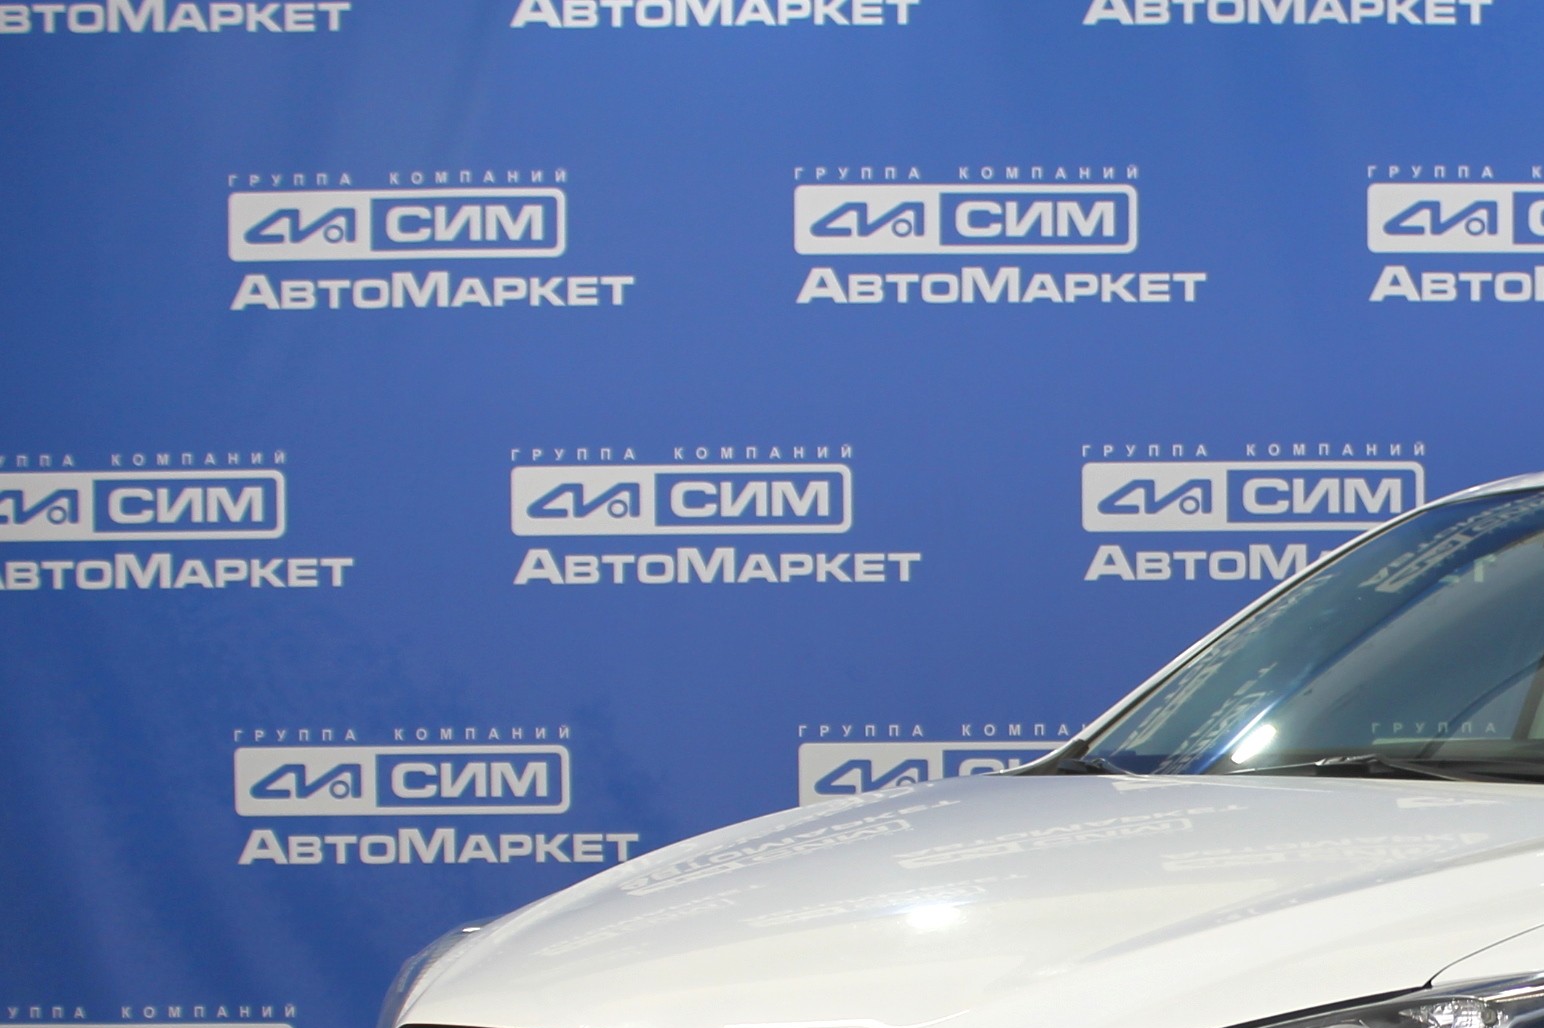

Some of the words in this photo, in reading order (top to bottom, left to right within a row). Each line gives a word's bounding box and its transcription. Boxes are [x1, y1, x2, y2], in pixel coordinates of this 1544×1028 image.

[0, 0, 351, 33] втоМаркет
[227, 172, 352, 187] ГРУППА
[389, 168, 567, 185] КОМПАНИЙ
[794, 166, 920, 180] ГРУППА
[958, 164, 1138, 180] КОМПАНИЙ
[1367, 164, 1494, 178] ГРУППА
[385, 204, 544, 242] СИМ
[955, 200, 1115, 237] СИМ
[111, 449, 286, 466] КОМПАНИЙ
[511, 447, 635, 461] ГРУППА
[673, 443, 852, 460] КОМПАНИЙ
[1081, 443, 1207, 457] ГРУППА
[1246, 441, 1425, 457] КОМПАНИЙ
[108, 486, 264, 524] СИМ
[670, 480, 830, 518] СИМ
[1242, 478, 1402, 514] СИМ
[0, 552, 354, 590] втоМаркет
[233, 728, 357, 742] ГРУППА
[394, 724, 570, 741] КОМПАНИЙ
[798, 724, 923, 738] ГРУППА
[391, 761, 548, 799] СИМ
[121, 1003, 296, 1019] КОМПАНИЙ
